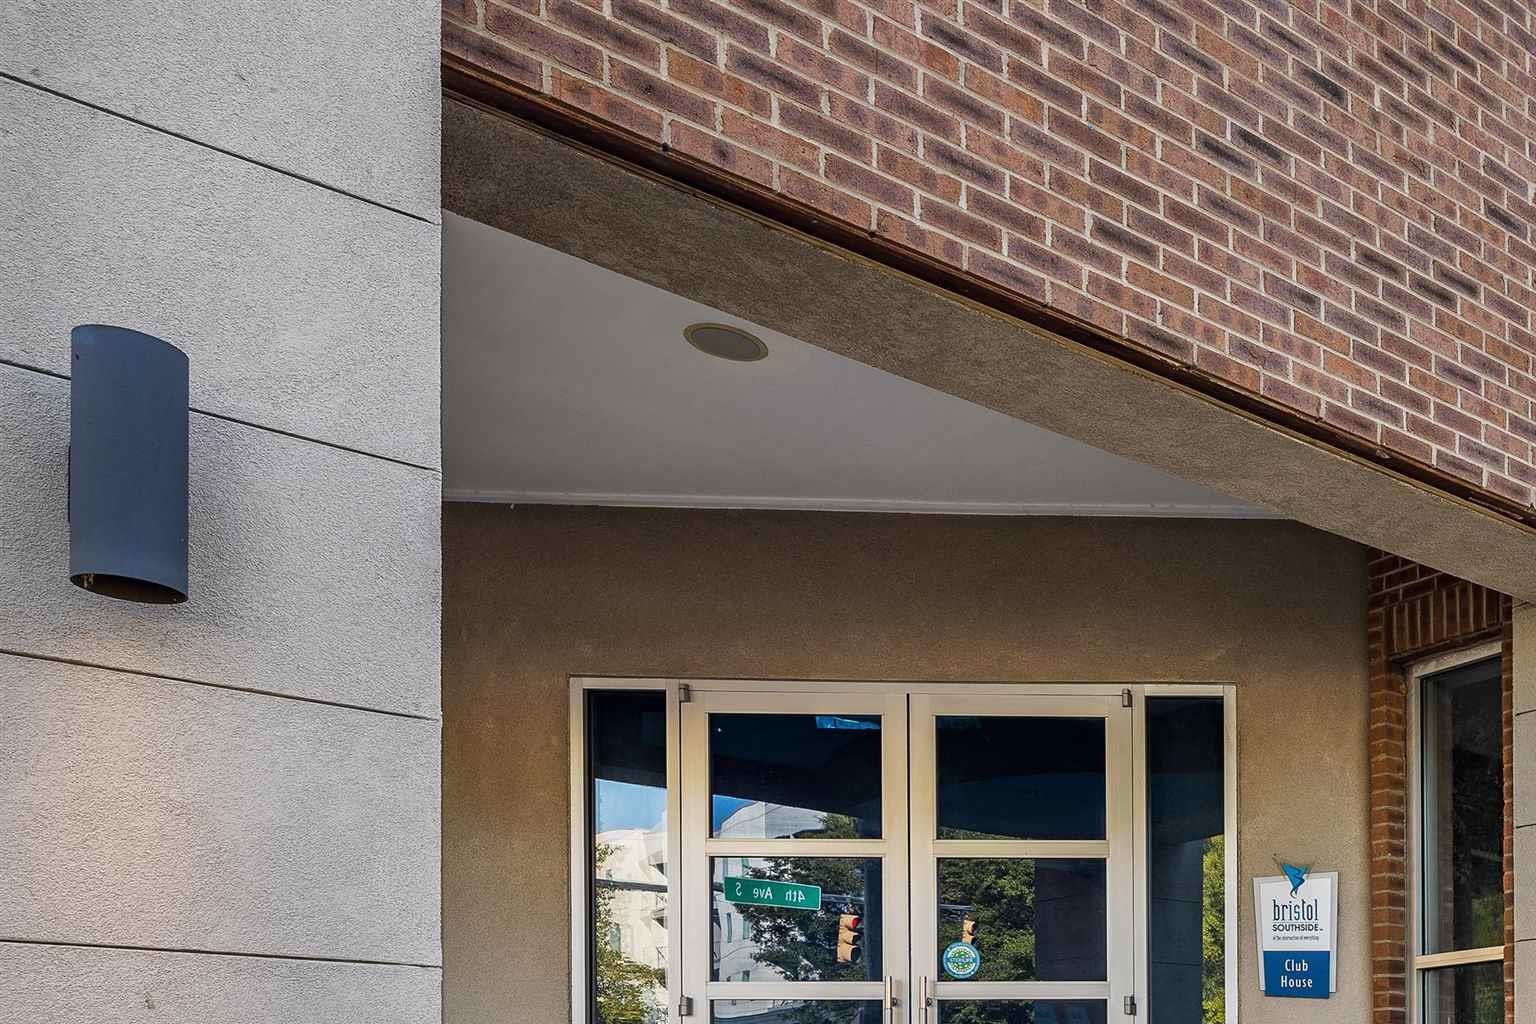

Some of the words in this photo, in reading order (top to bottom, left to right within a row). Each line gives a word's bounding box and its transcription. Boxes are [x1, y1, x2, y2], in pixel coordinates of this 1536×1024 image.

[1272, 899, 1318, 921] bristol
[1272, 923, 1319, 932] SOUTHSIDE
[1284, 959, 1309, 972] Club
[1280, 975, 1313, 988] House
